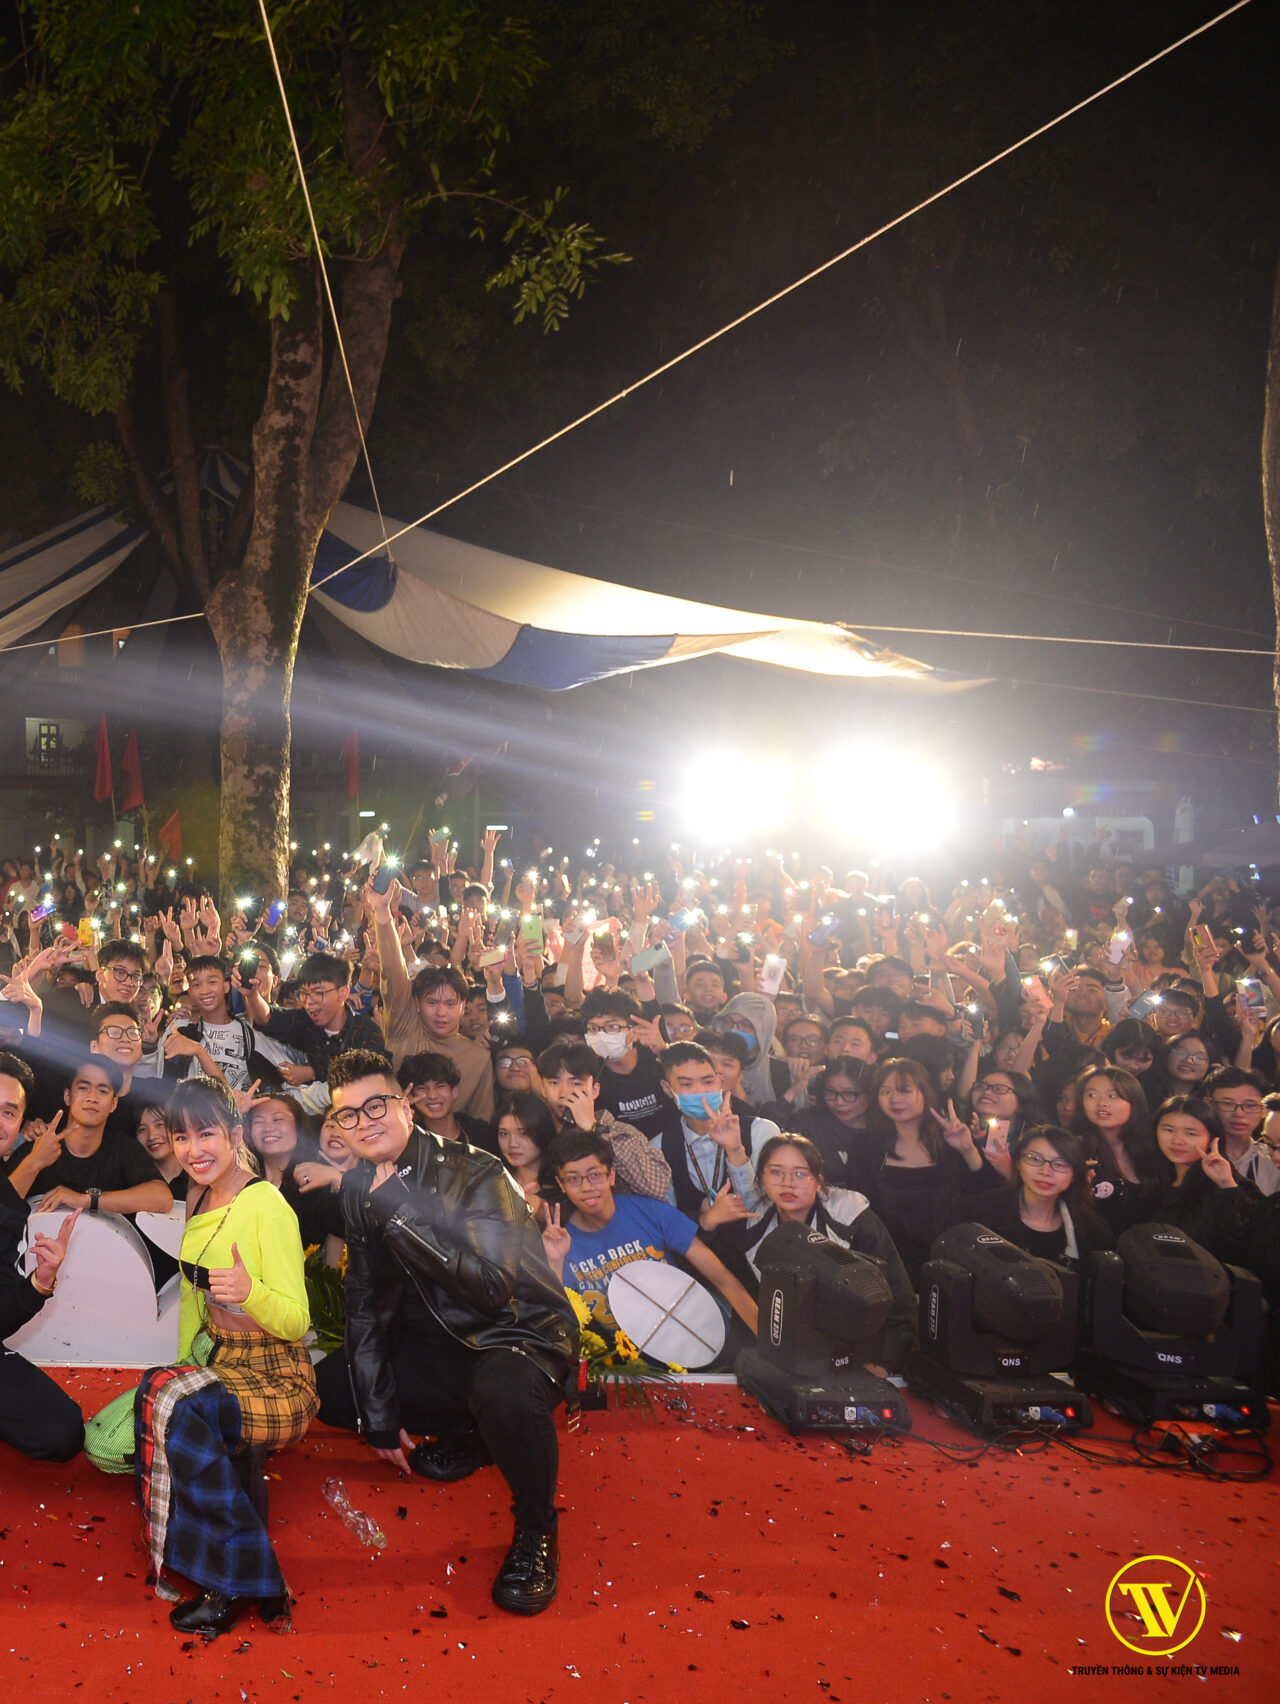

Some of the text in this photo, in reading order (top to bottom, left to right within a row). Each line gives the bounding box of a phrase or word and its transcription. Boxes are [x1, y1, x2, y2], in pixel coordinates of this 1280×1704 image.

[597, 1254, 606, 1265] 2
[608, 1240, 643, 1260] BACK
[773, 1297, 781, 1322] BEAM
[835, 1356, 849, 1367] QNS
[1002, 1358, 1020, 1367] QNS
[1157, 1353, 1182, 1364] QNS
